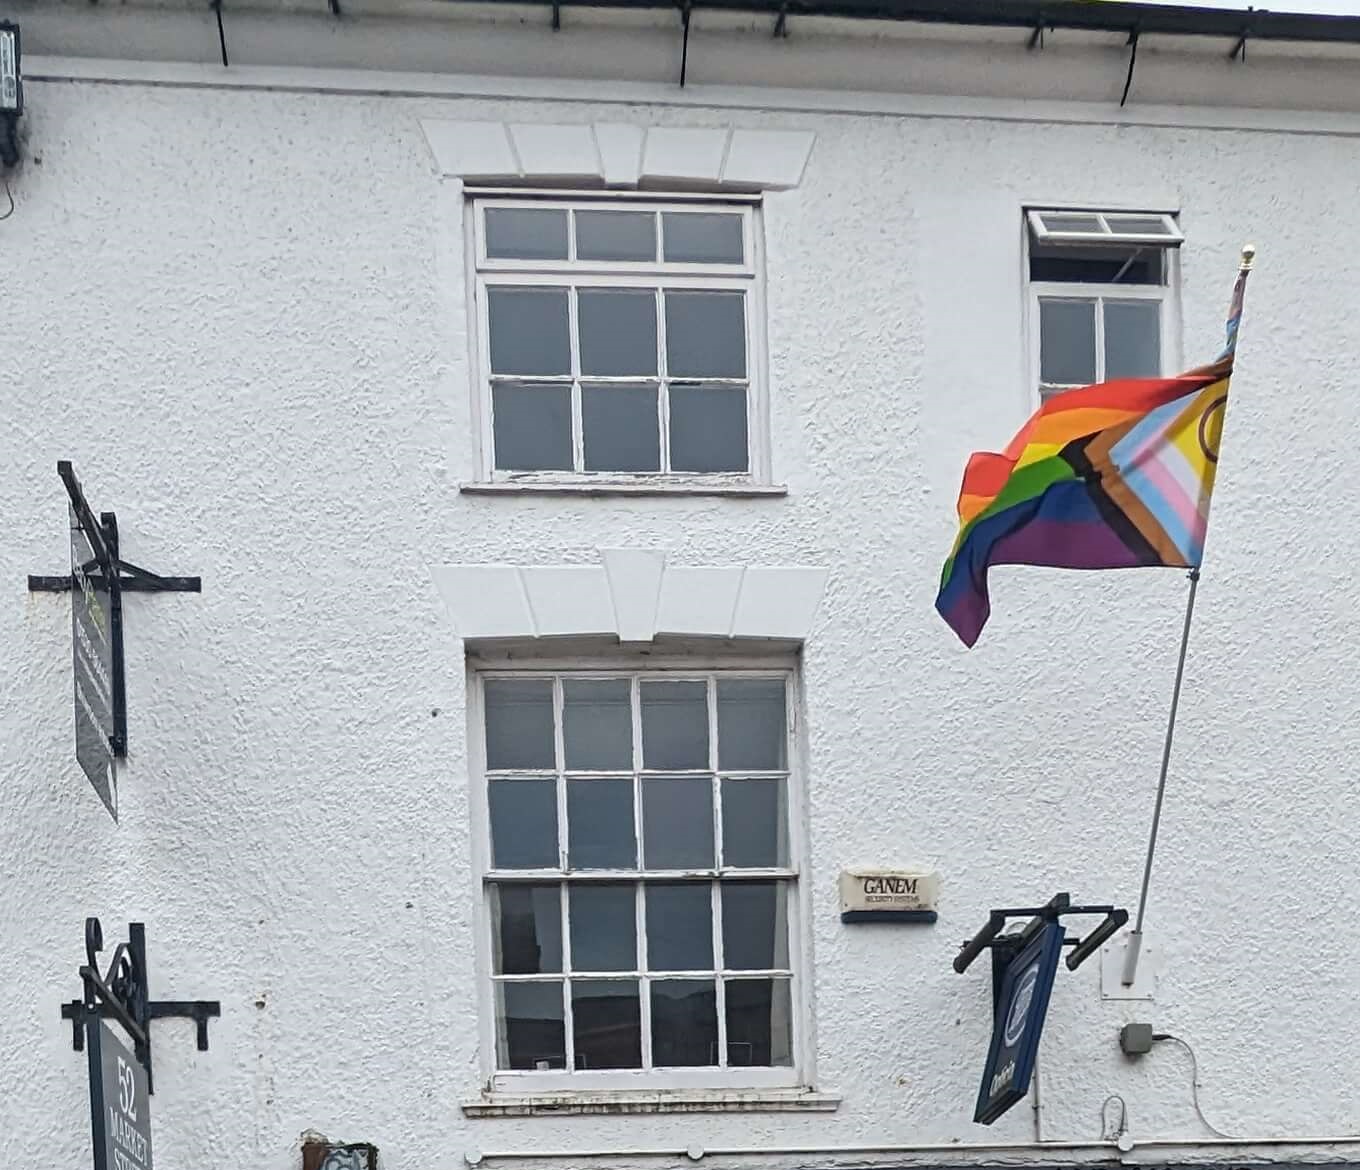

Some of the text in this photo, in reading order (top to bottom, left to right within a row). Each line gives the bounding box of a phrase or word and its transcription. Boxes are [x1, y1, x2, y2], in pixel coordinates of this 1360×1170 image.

[864, 879, 918, 894] GANEM
[117, 1056, 137, 1122] 52
[109, 1106, 148, 1167] MARKET
